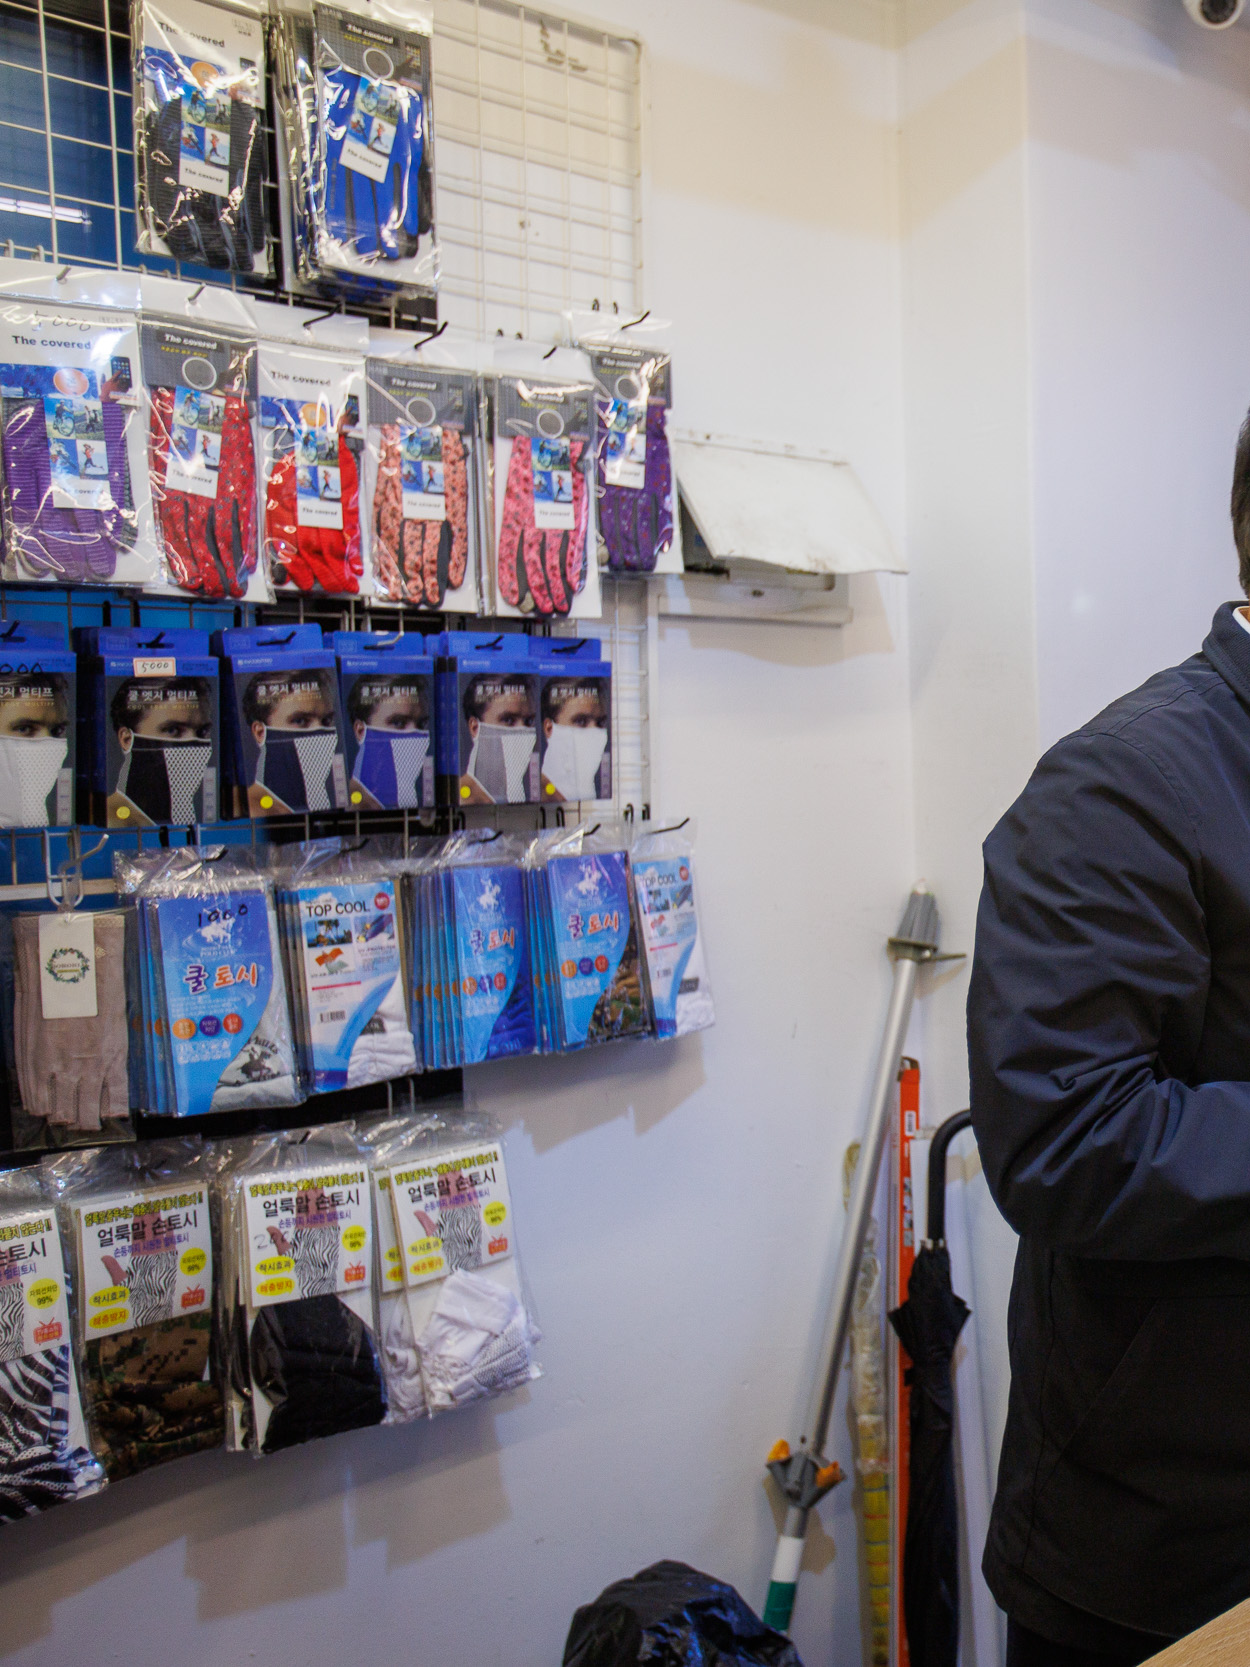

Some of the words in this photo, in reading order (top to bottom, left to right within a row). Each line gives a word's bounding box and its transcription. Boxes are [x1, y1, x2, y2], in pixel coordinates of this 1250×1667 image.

[12, 335, 37, 346] The
[41, 339, 91, 350] covered
[164, 333, 182, 343] The
[183, 338, 218, 350] covered
[271, 371, 290, 380] The
[292, 375, 331, 386] covered
[141, 661, 169, 673] 5000
[19, 686, 54, 698] 멀티프
[306, 903, 333, 918] TOP
[335, 900, 367, 915] COOL
[567, 913, 585, 941] 쿨
[586, 910, 619, 936] 토시
[469, 928, 486, 956] 쿨
[487, 926, 516, 951] 토시
[183, 963, 209, 994] 쿨
[213, 961, 259, 989] 토시
[408, 1178, 450, 1203] 얼룩말
[455, 1167, 497, 1192] 손토시
[263, 1193, 309, 1218] 얼룩말
[315, 1188, 360, 1211] 손토시
[97, 1219, 147, 1248] 얼룩말
[151, 1208, 199, 1237] 손토시
[4, 1262, 38, 1280] 멀티토시
[93, 1289, 126, 1305] 착시효과
[93, 1310, 127, 1326] 해충방지
